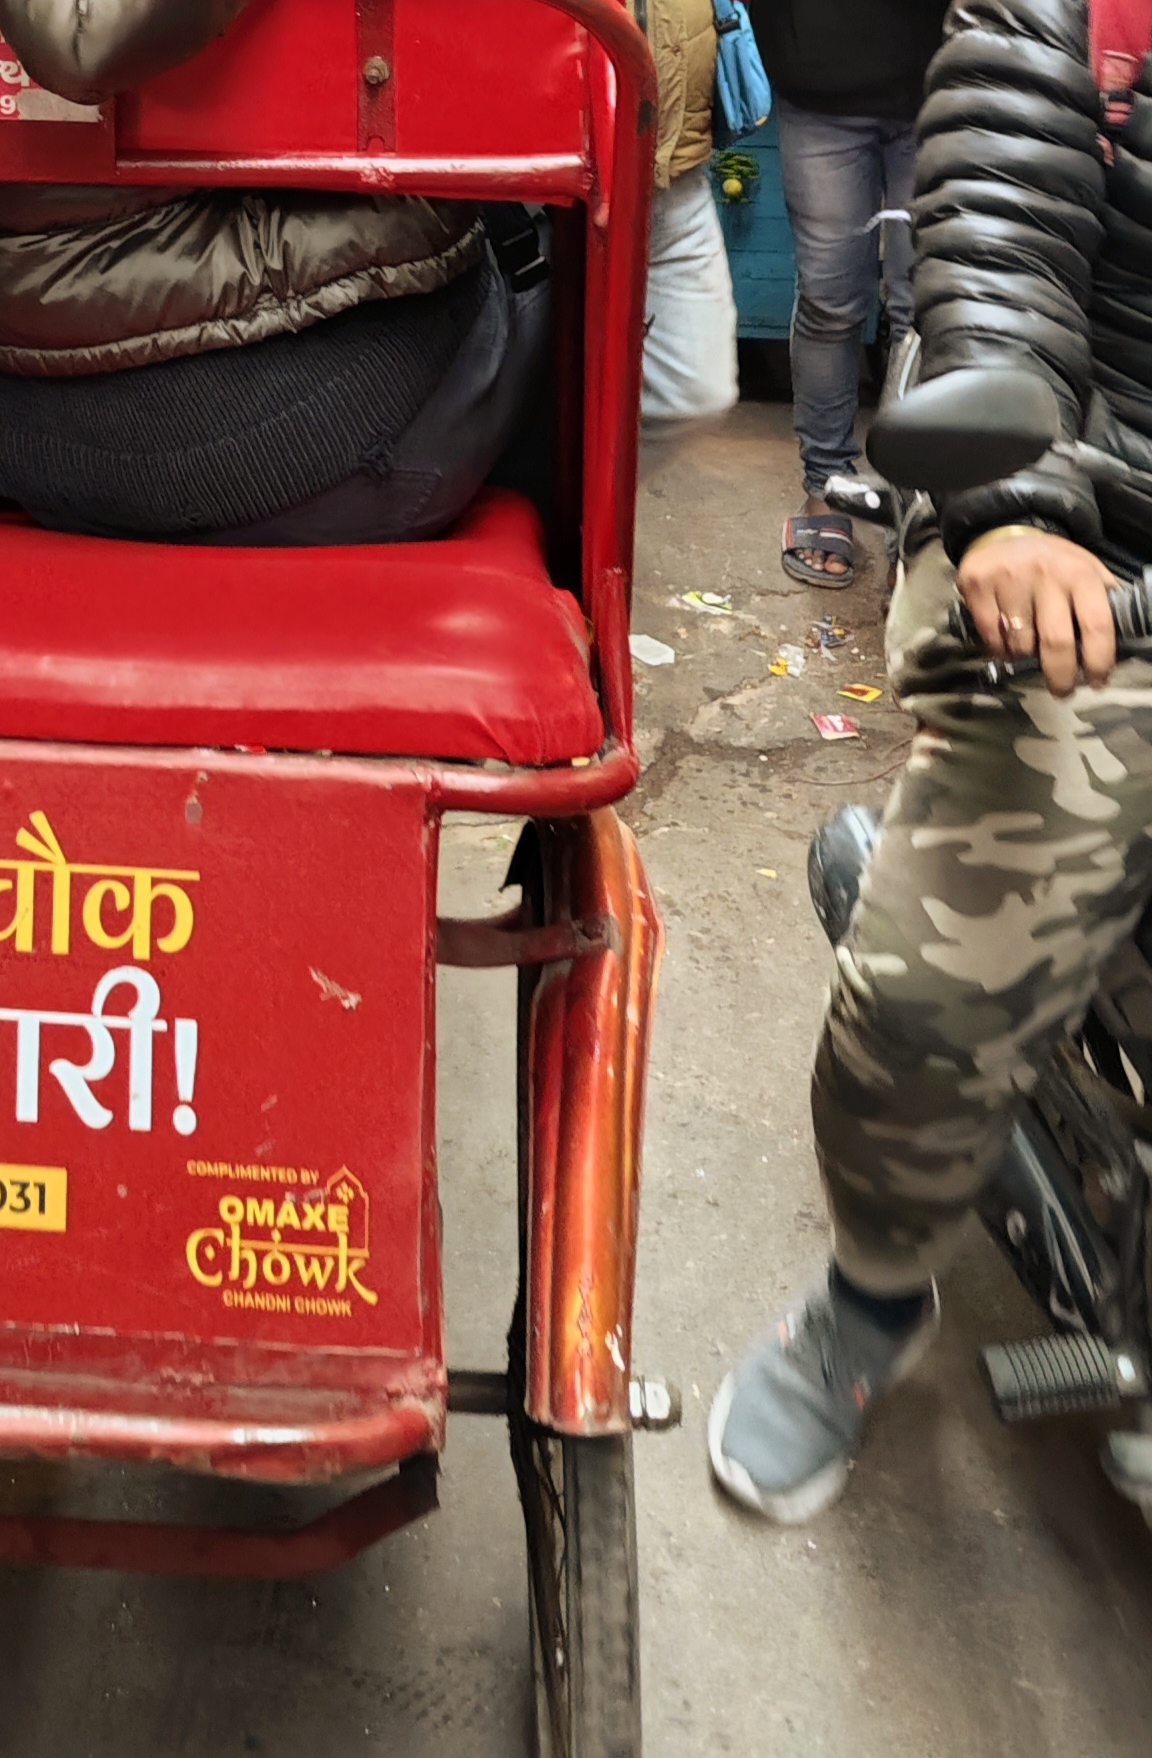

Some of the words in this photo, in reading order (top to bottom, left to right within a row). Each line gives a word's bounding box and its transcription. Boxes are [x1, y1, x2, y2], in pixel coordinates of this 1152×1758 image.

[186, 1159, 298, 1184] COMPLIMENTED
[300, 1167, 320, 1186] BY
[218, 1194, 350, 1233] OMAXE
[185, 1222, 379, 1306] Chowk
[222, 1288, 292, 1314] CHANDNI
[294, 1295, 353, 1318] CHOWK
